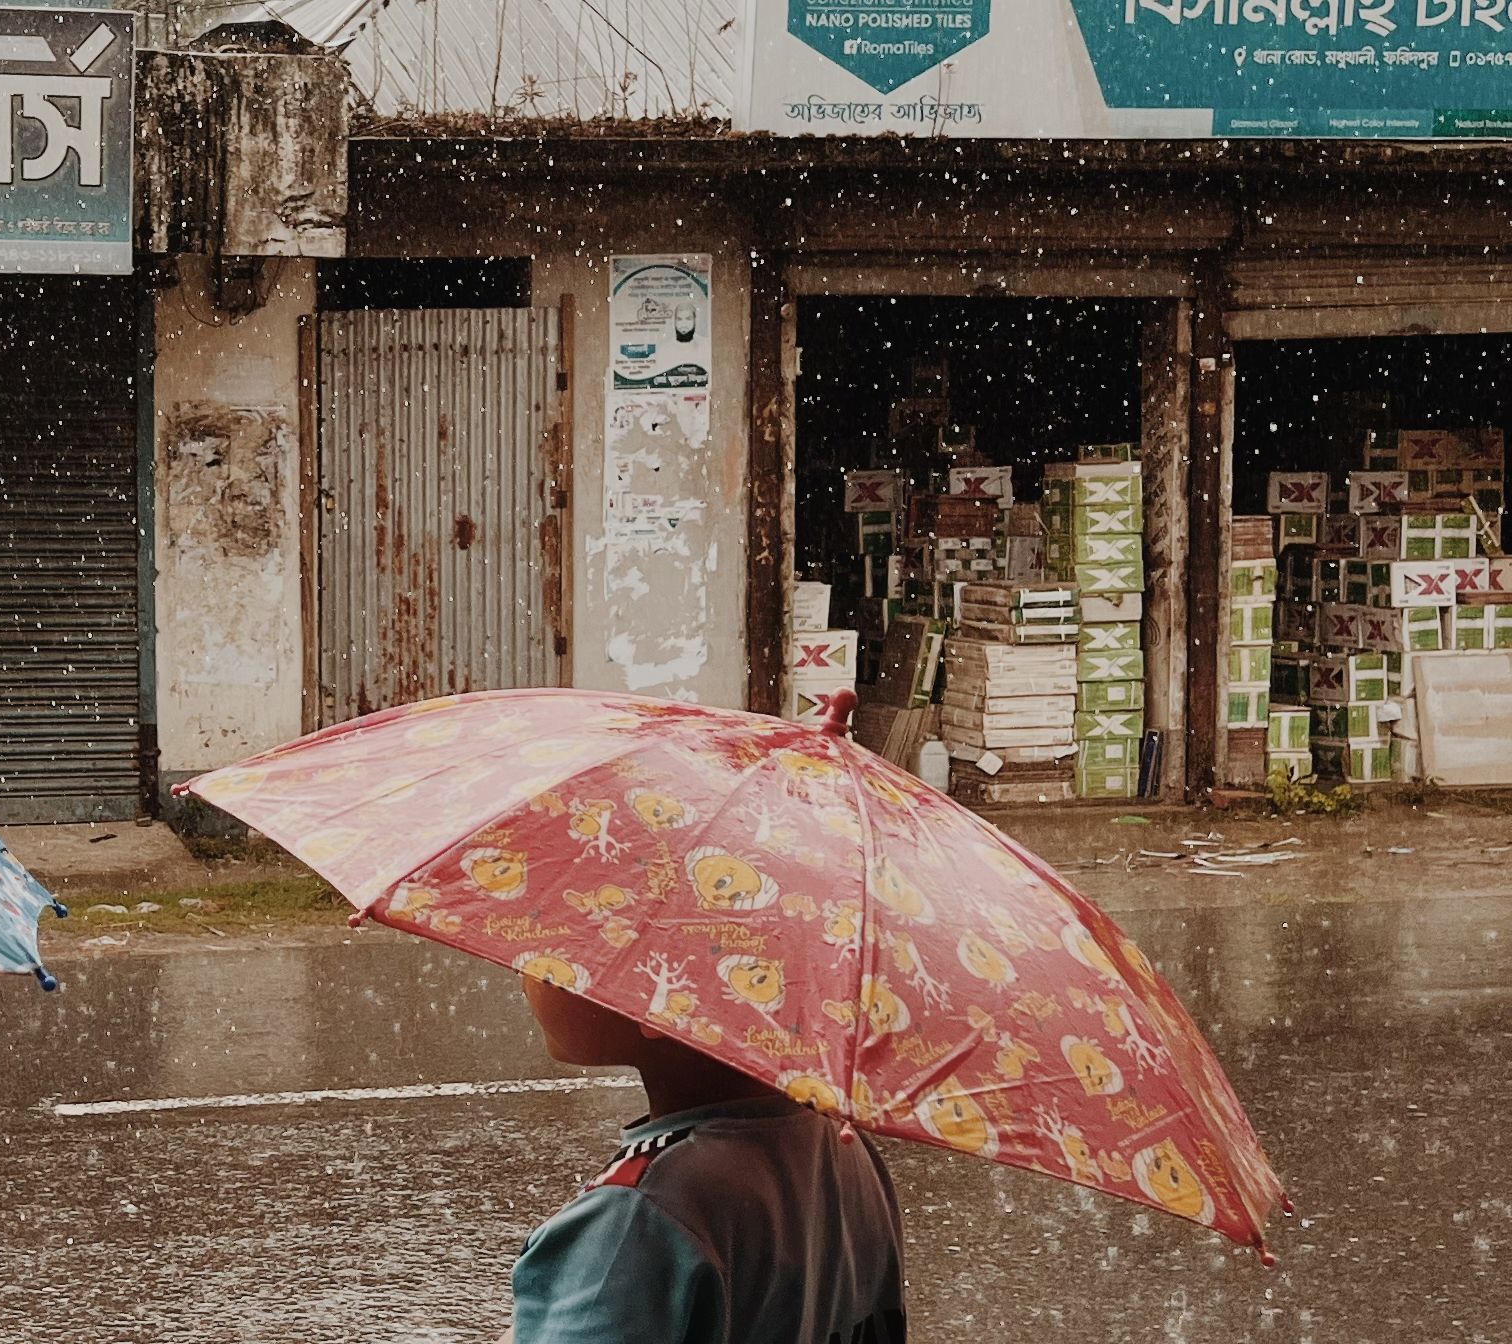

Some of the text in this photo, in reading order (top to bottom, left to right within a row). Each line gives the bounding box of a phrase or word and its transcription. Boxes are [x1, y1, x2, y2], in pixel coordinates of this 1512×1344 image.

[805, 13, 972, 28] NANO POLISHED TILES
[861, 40, 934, 55] RomaTiles
[1383, 46, 1439, 70] ফরিদপুর
[784, 94, 883, 123] অভিজাতের
